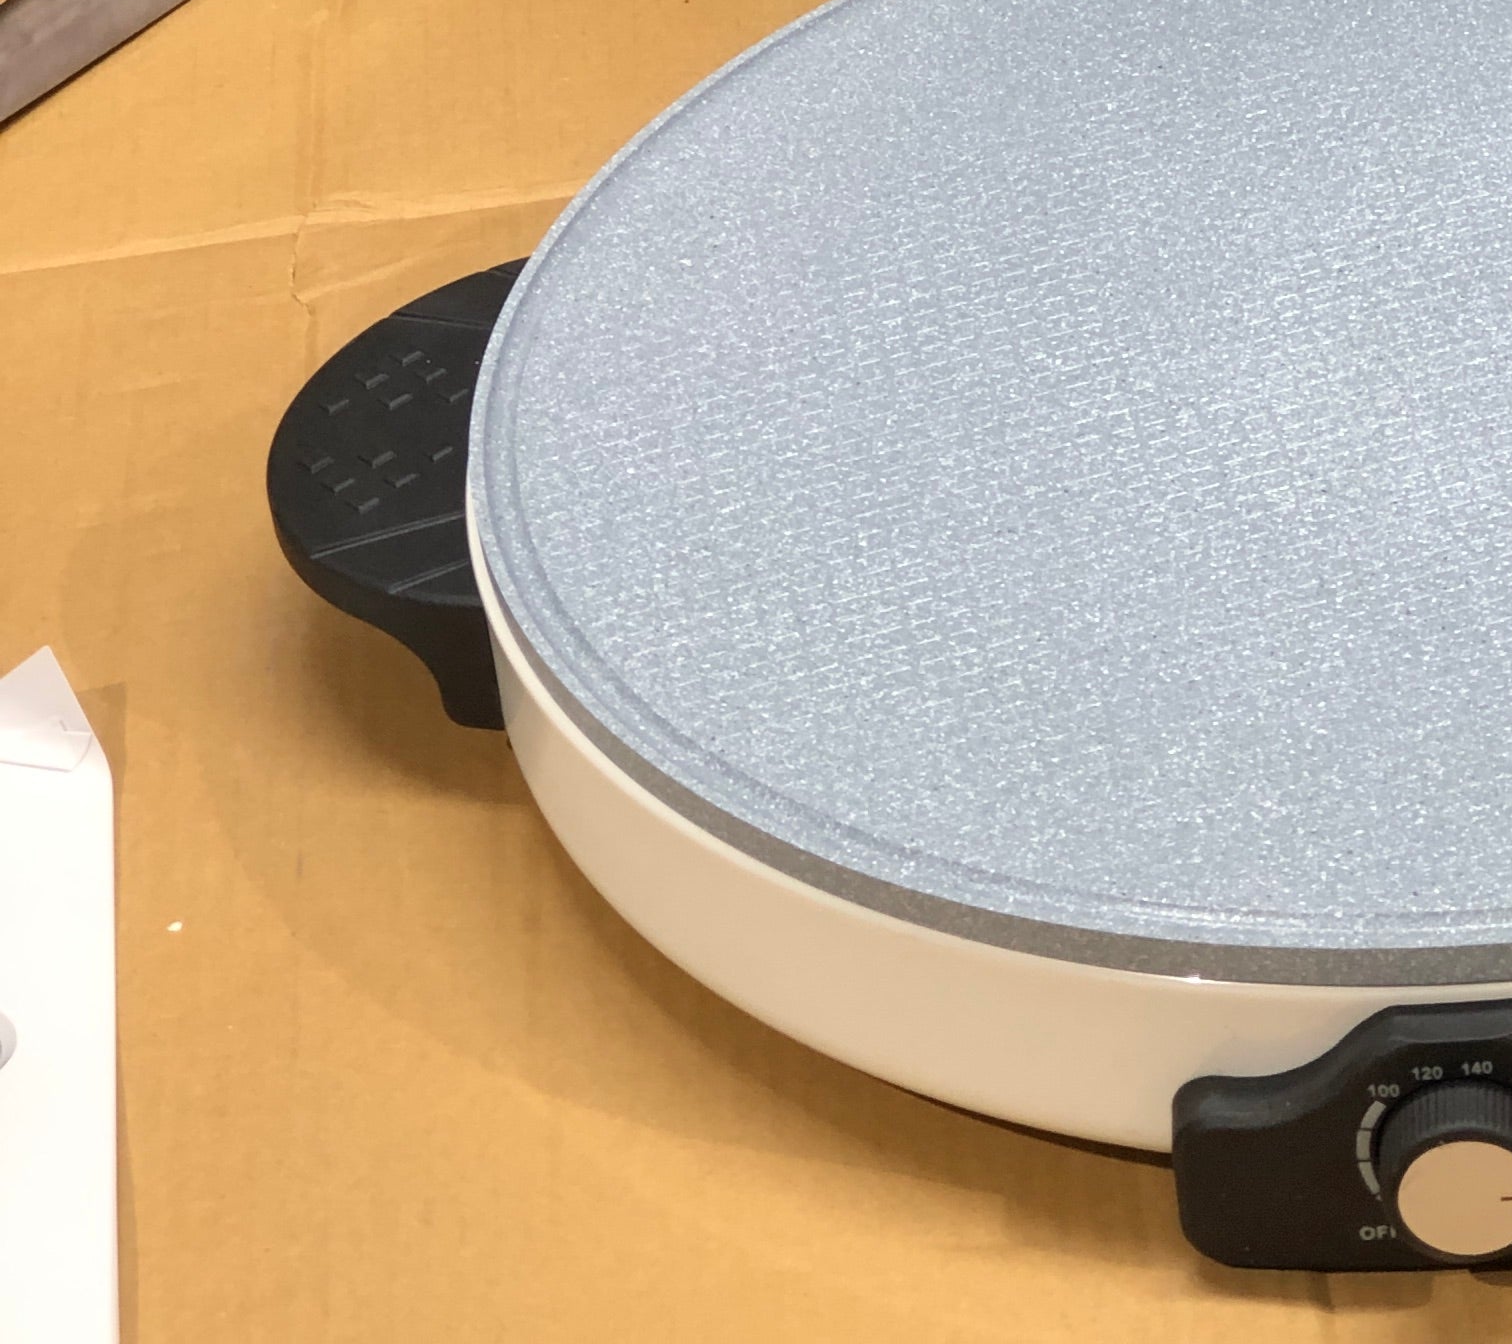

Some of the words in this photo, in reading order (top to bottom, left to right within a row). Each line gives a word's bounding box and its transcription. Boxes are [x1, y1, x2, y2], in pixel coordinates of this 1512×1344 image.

[1411, 1066, 1444, 1081] 120
[1461, 1061, 1493, 1076] 140
[1367, 1083, 1400, 1098] 100
